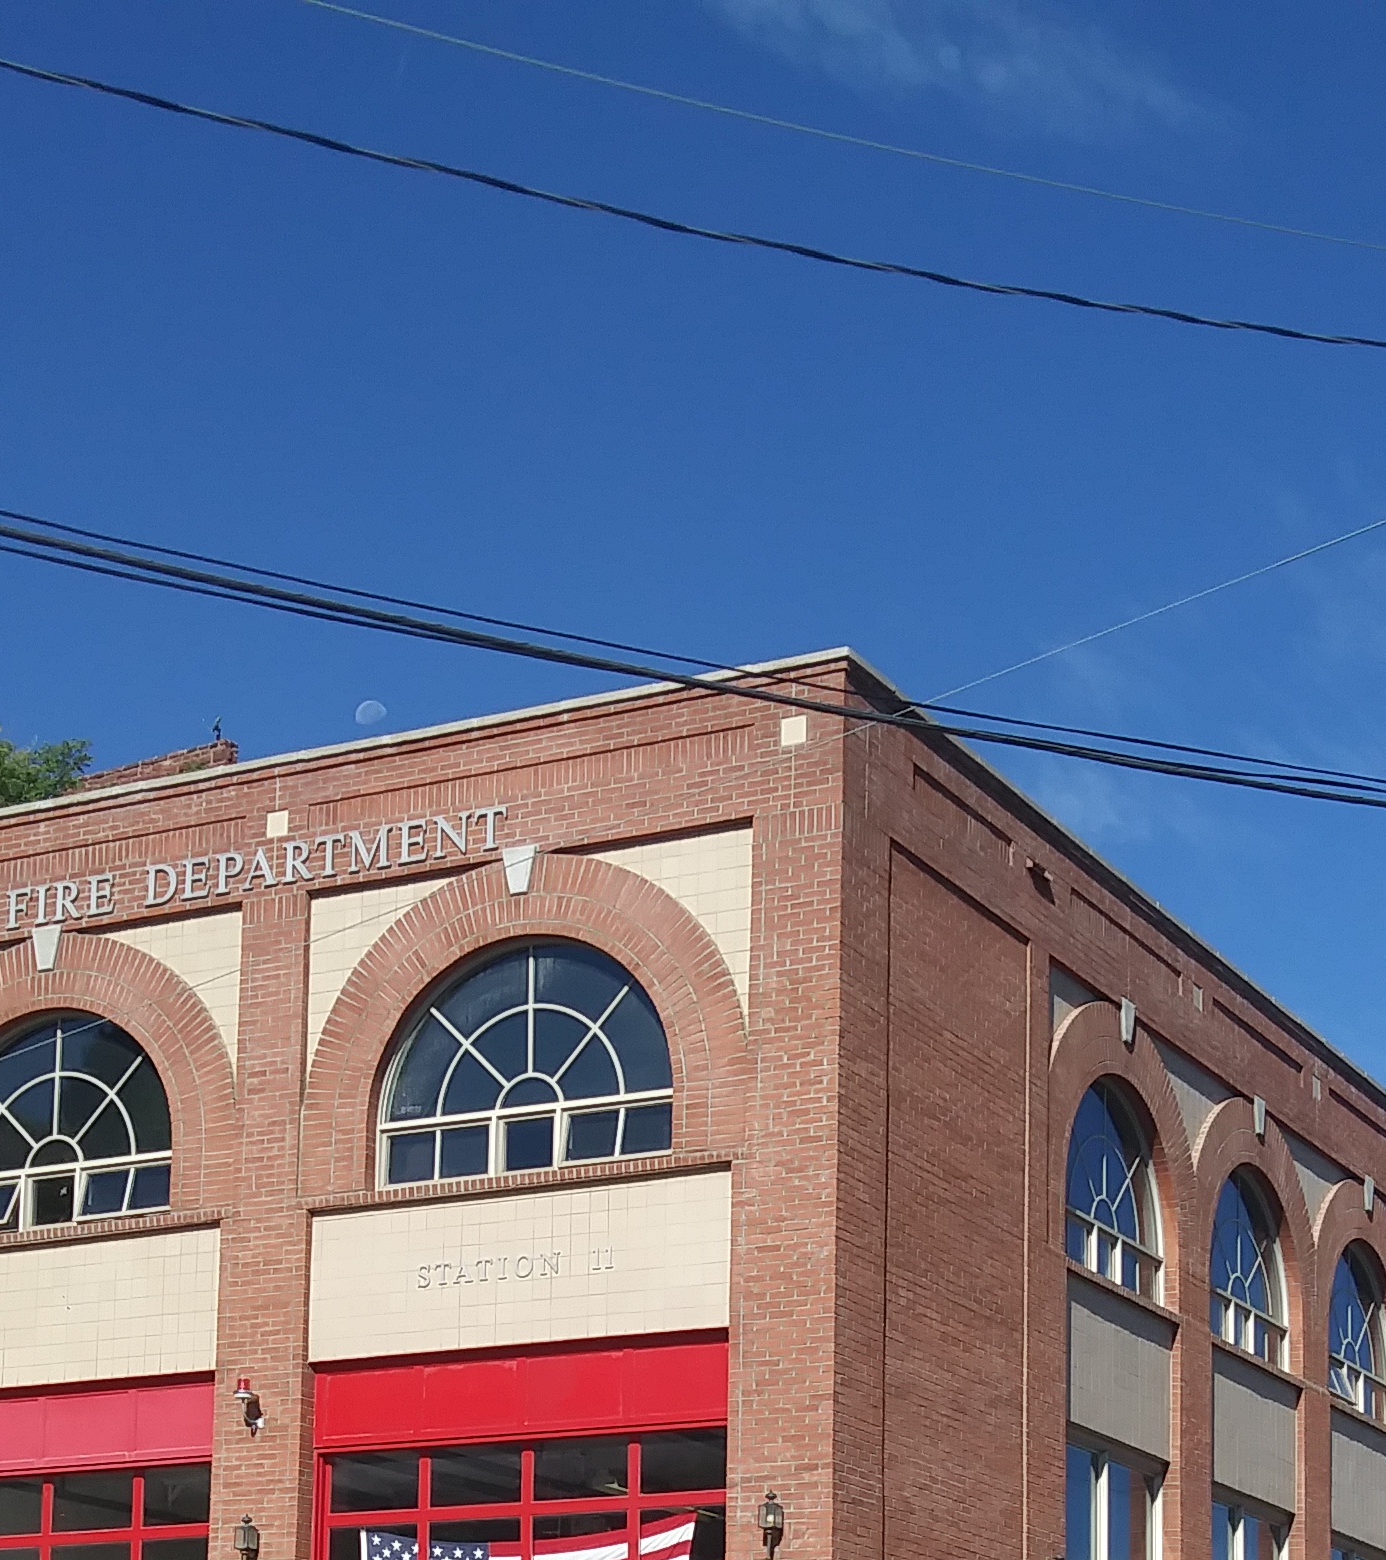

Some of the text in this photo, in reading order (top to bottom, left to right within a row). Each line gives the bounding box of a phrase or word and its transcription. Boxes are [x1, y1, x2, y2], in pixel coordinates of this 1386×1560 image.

[6, 874, 115, 931] FIRE
[144, 806, 508, 907] DEPARTMENT
[417, 1251, 562, 1289] STATION
